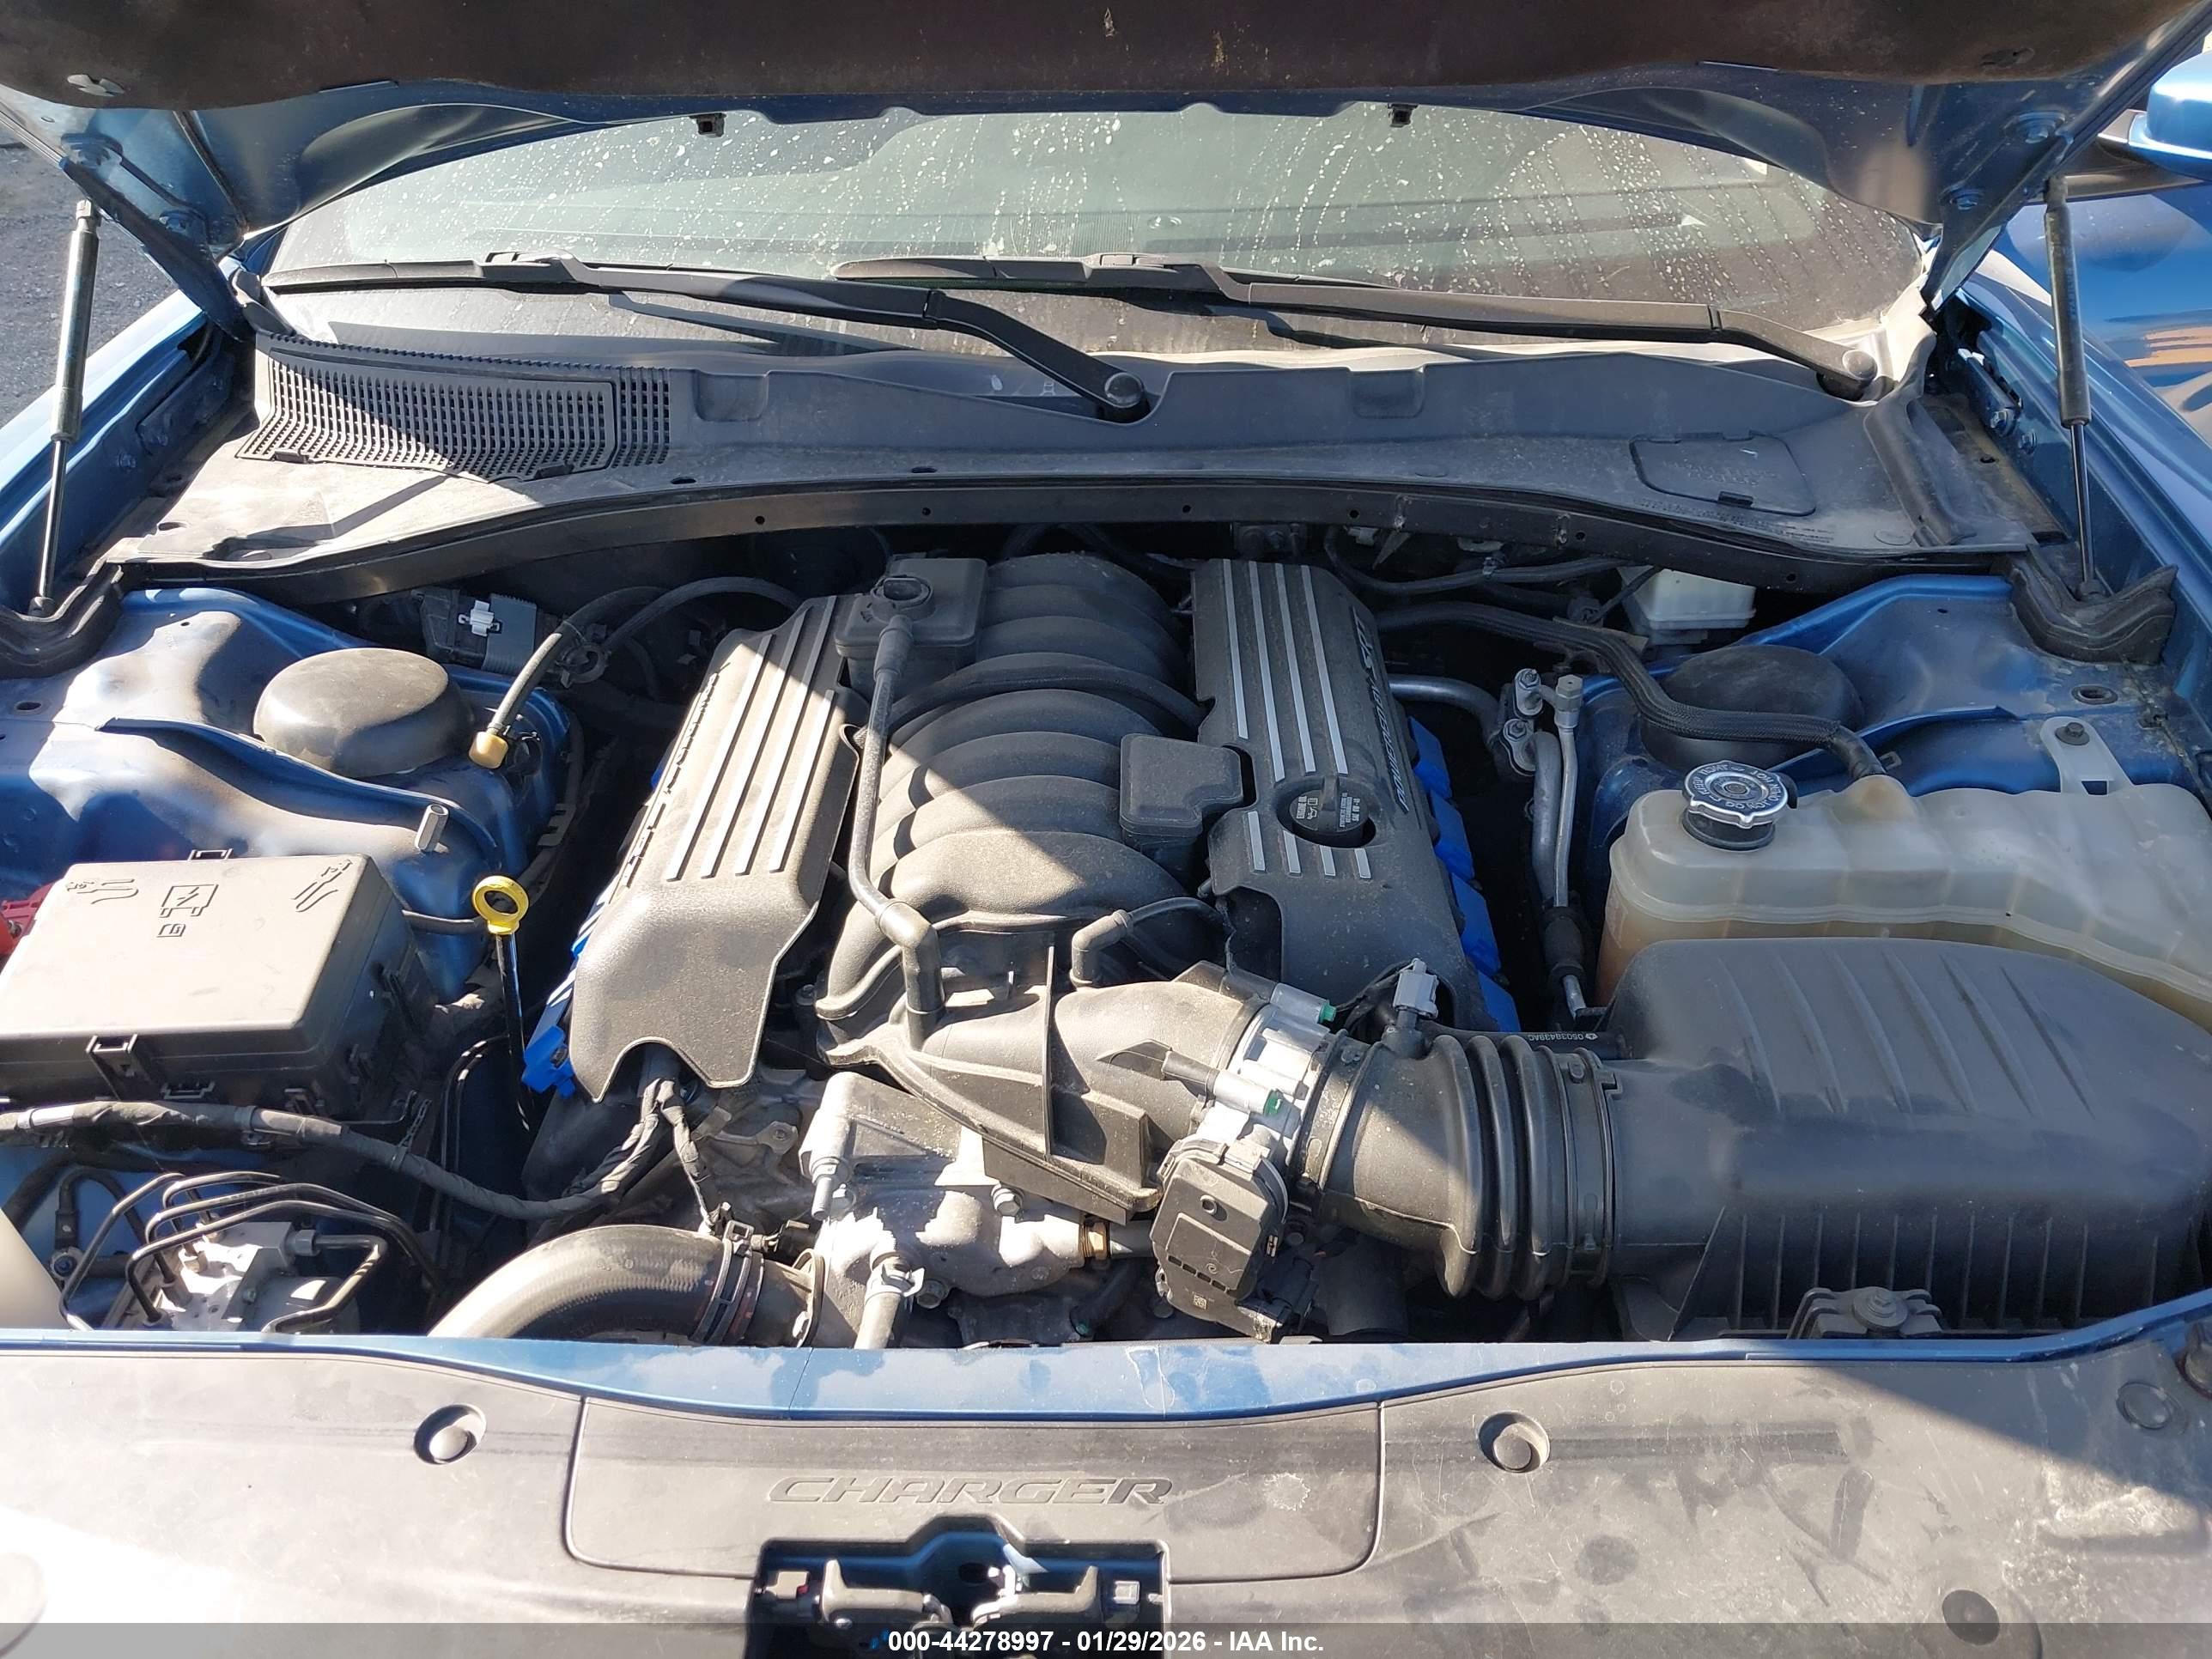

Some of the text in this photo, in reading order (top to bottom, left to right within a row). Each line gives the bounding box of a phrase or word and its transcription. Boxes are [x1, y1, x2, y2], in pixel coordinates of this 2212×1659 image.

[1352, 605, 1376, 680] SRT
[1375, 706, 1409, 812] POWERED
[768, 1476, 1175, 1505] CHARGER
